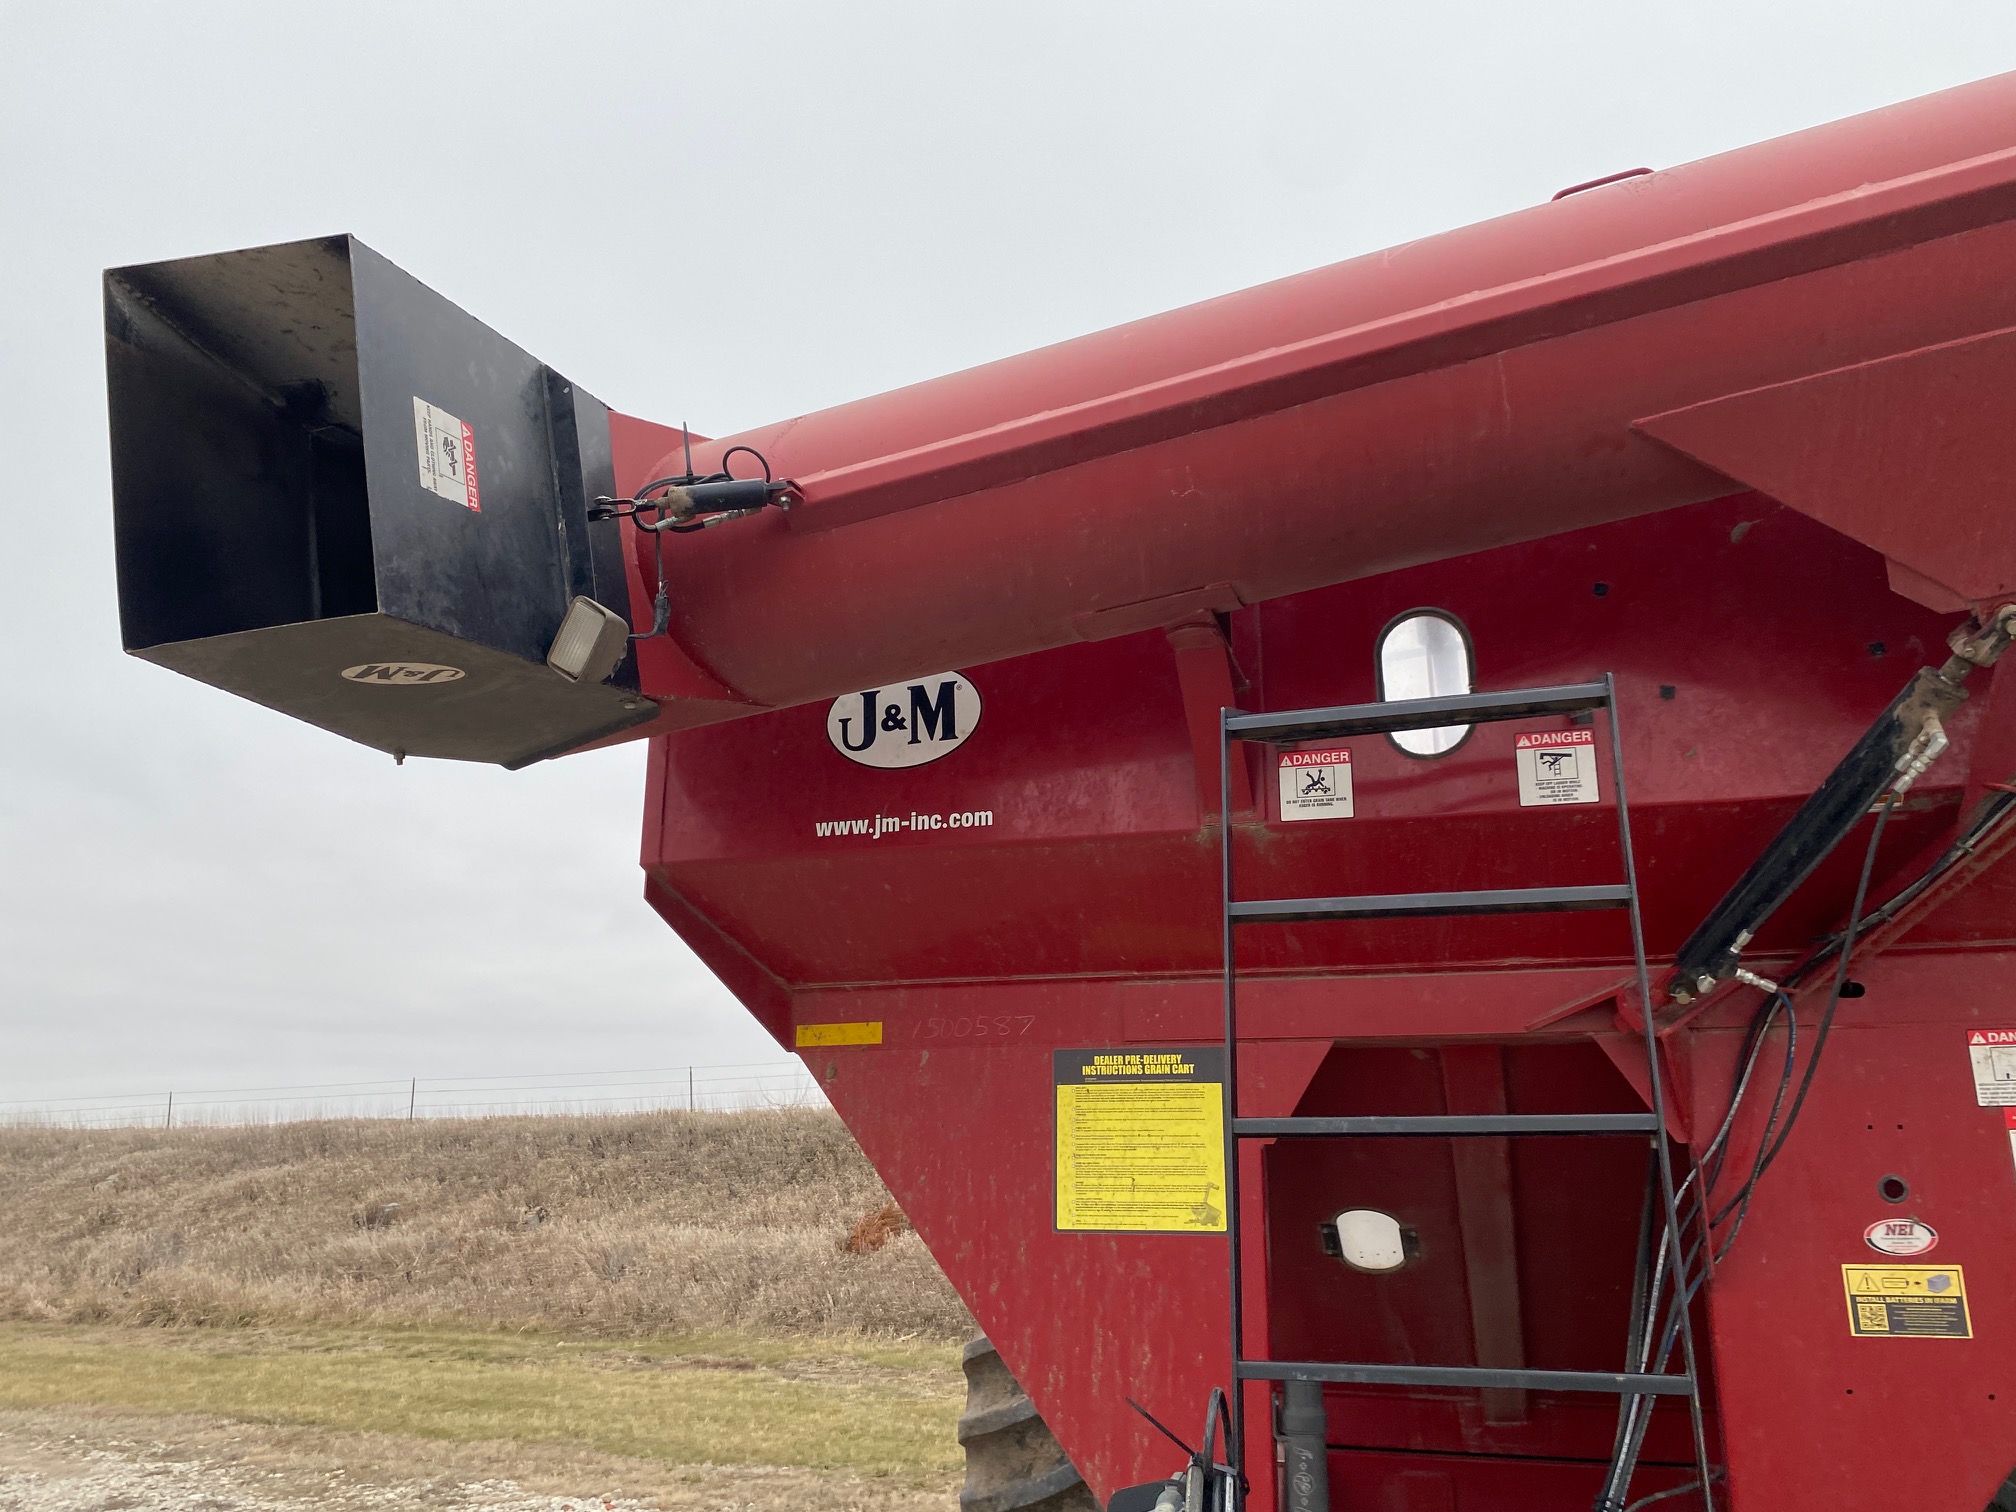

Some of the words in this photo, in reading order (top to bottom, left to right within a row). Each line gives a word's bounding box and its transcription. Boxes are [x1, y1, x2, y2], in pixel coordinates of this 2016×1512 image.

[464, 440, 478, 508] DANGER
[351, 665, 461, 682] J&M
[838, 680, 959, 752] J&M
[1531, 731, 1592, 745] DANGER
[1293, 751, 1349, 765] DANGER
[815, 809, 993, 839] www.jm-inc.com
[911, 1015, 1036, 1039] 1500587
[1094, 1055, 1124, 1065] DEALER
[1125, 1054, 1182, 1065] PRE-DELIVERY
[1082, 1065, 1143, 1076] INSTRUCTIONS
[1144, 1064, 1171, 1075] GRAIN
[1172, 1063, 1195, 1074] CART
[1885, 1224, 1915, 1236] NEI
